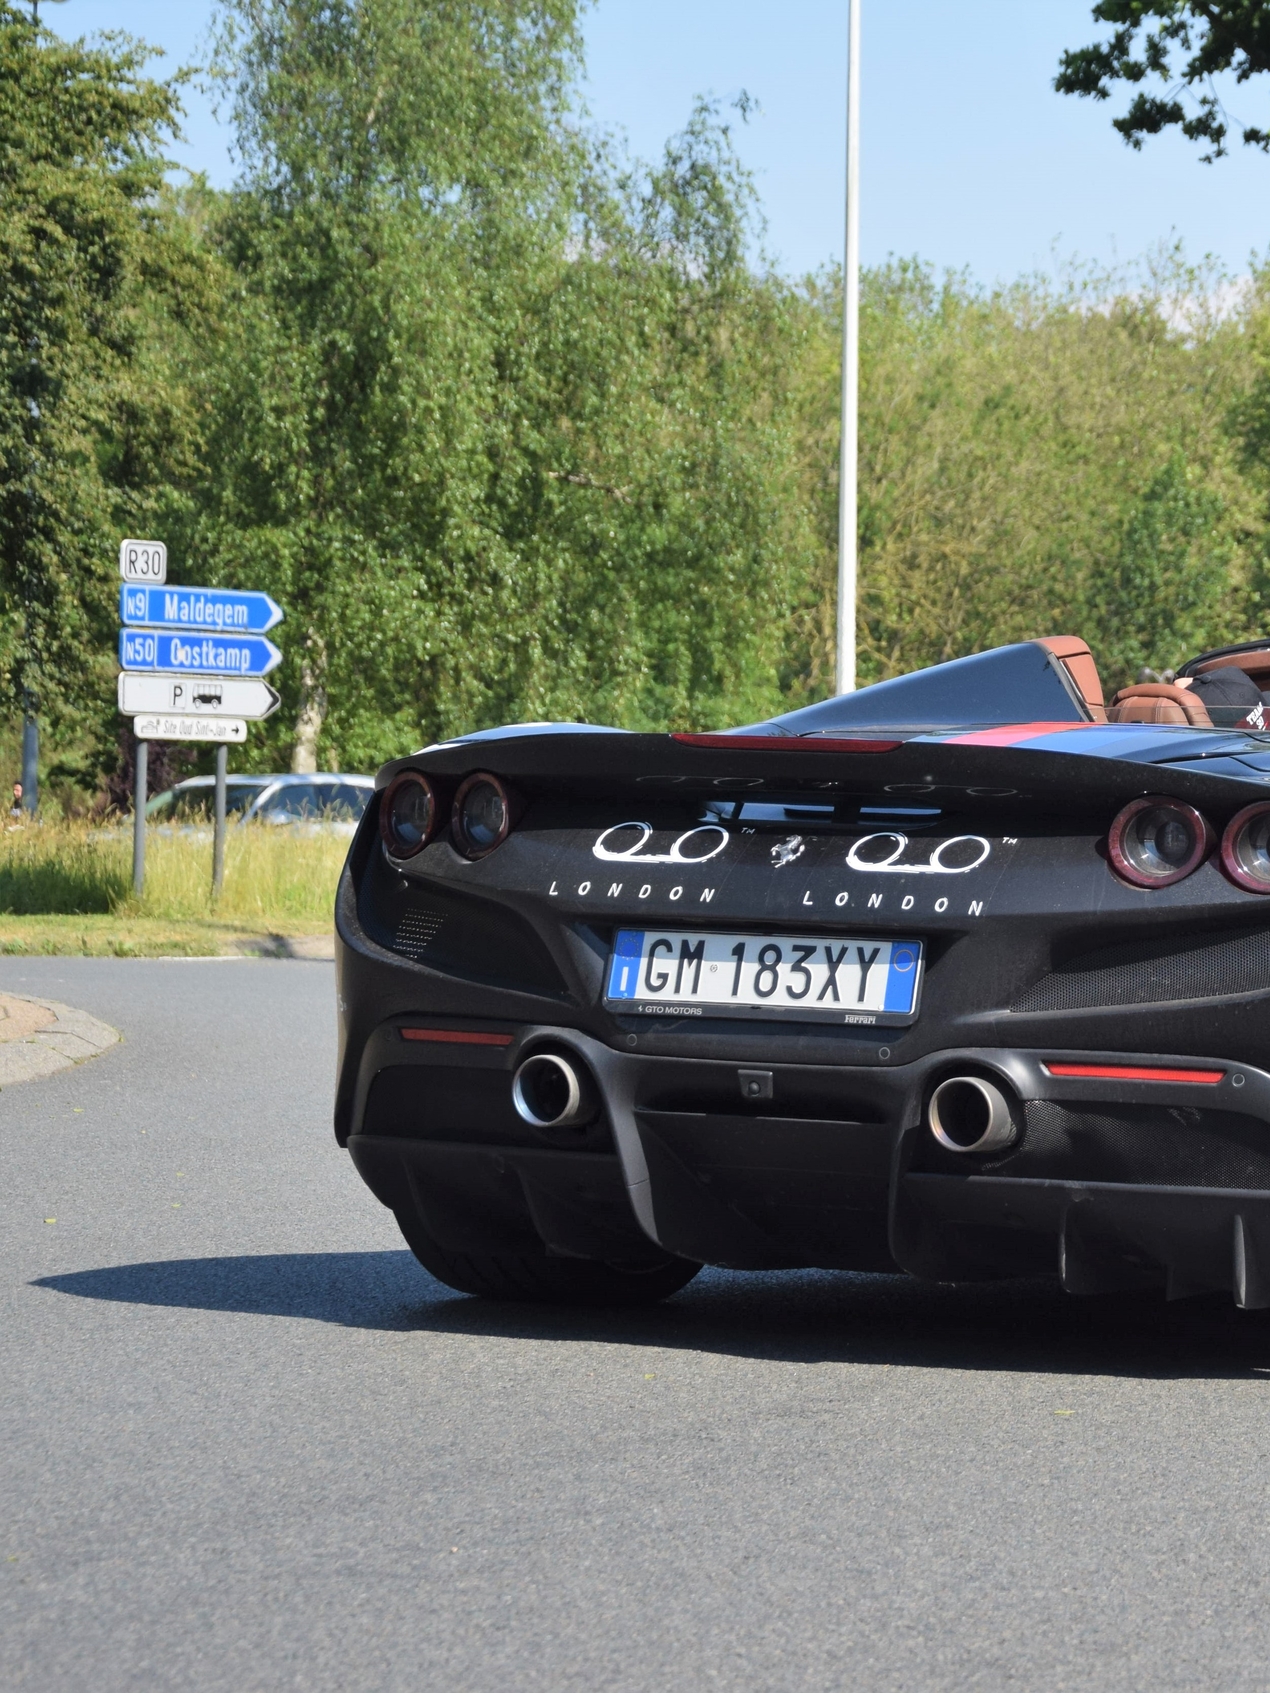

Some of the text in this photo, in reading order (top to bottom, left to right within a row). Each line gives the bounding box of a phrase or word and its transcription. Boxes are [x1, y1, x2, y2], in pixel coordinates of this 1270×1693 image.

[128, 549, 161, 576] R30
[127, 592, 249, 630] N9 Maldegem
[126, 637, 251, 675] N50 Oostkamp
[173, 685, 183, 706] P
[163, 719, 177, 734] Site
[548, 881, 716, 903] LONDON
[802, 890, 983, 917] LONDON
[644, 938, 882, 1003] GM 183XY
[645, 1005, 703, 1016] GTO MOTORS
[844, 1014, 877, 1025] Ferrari
